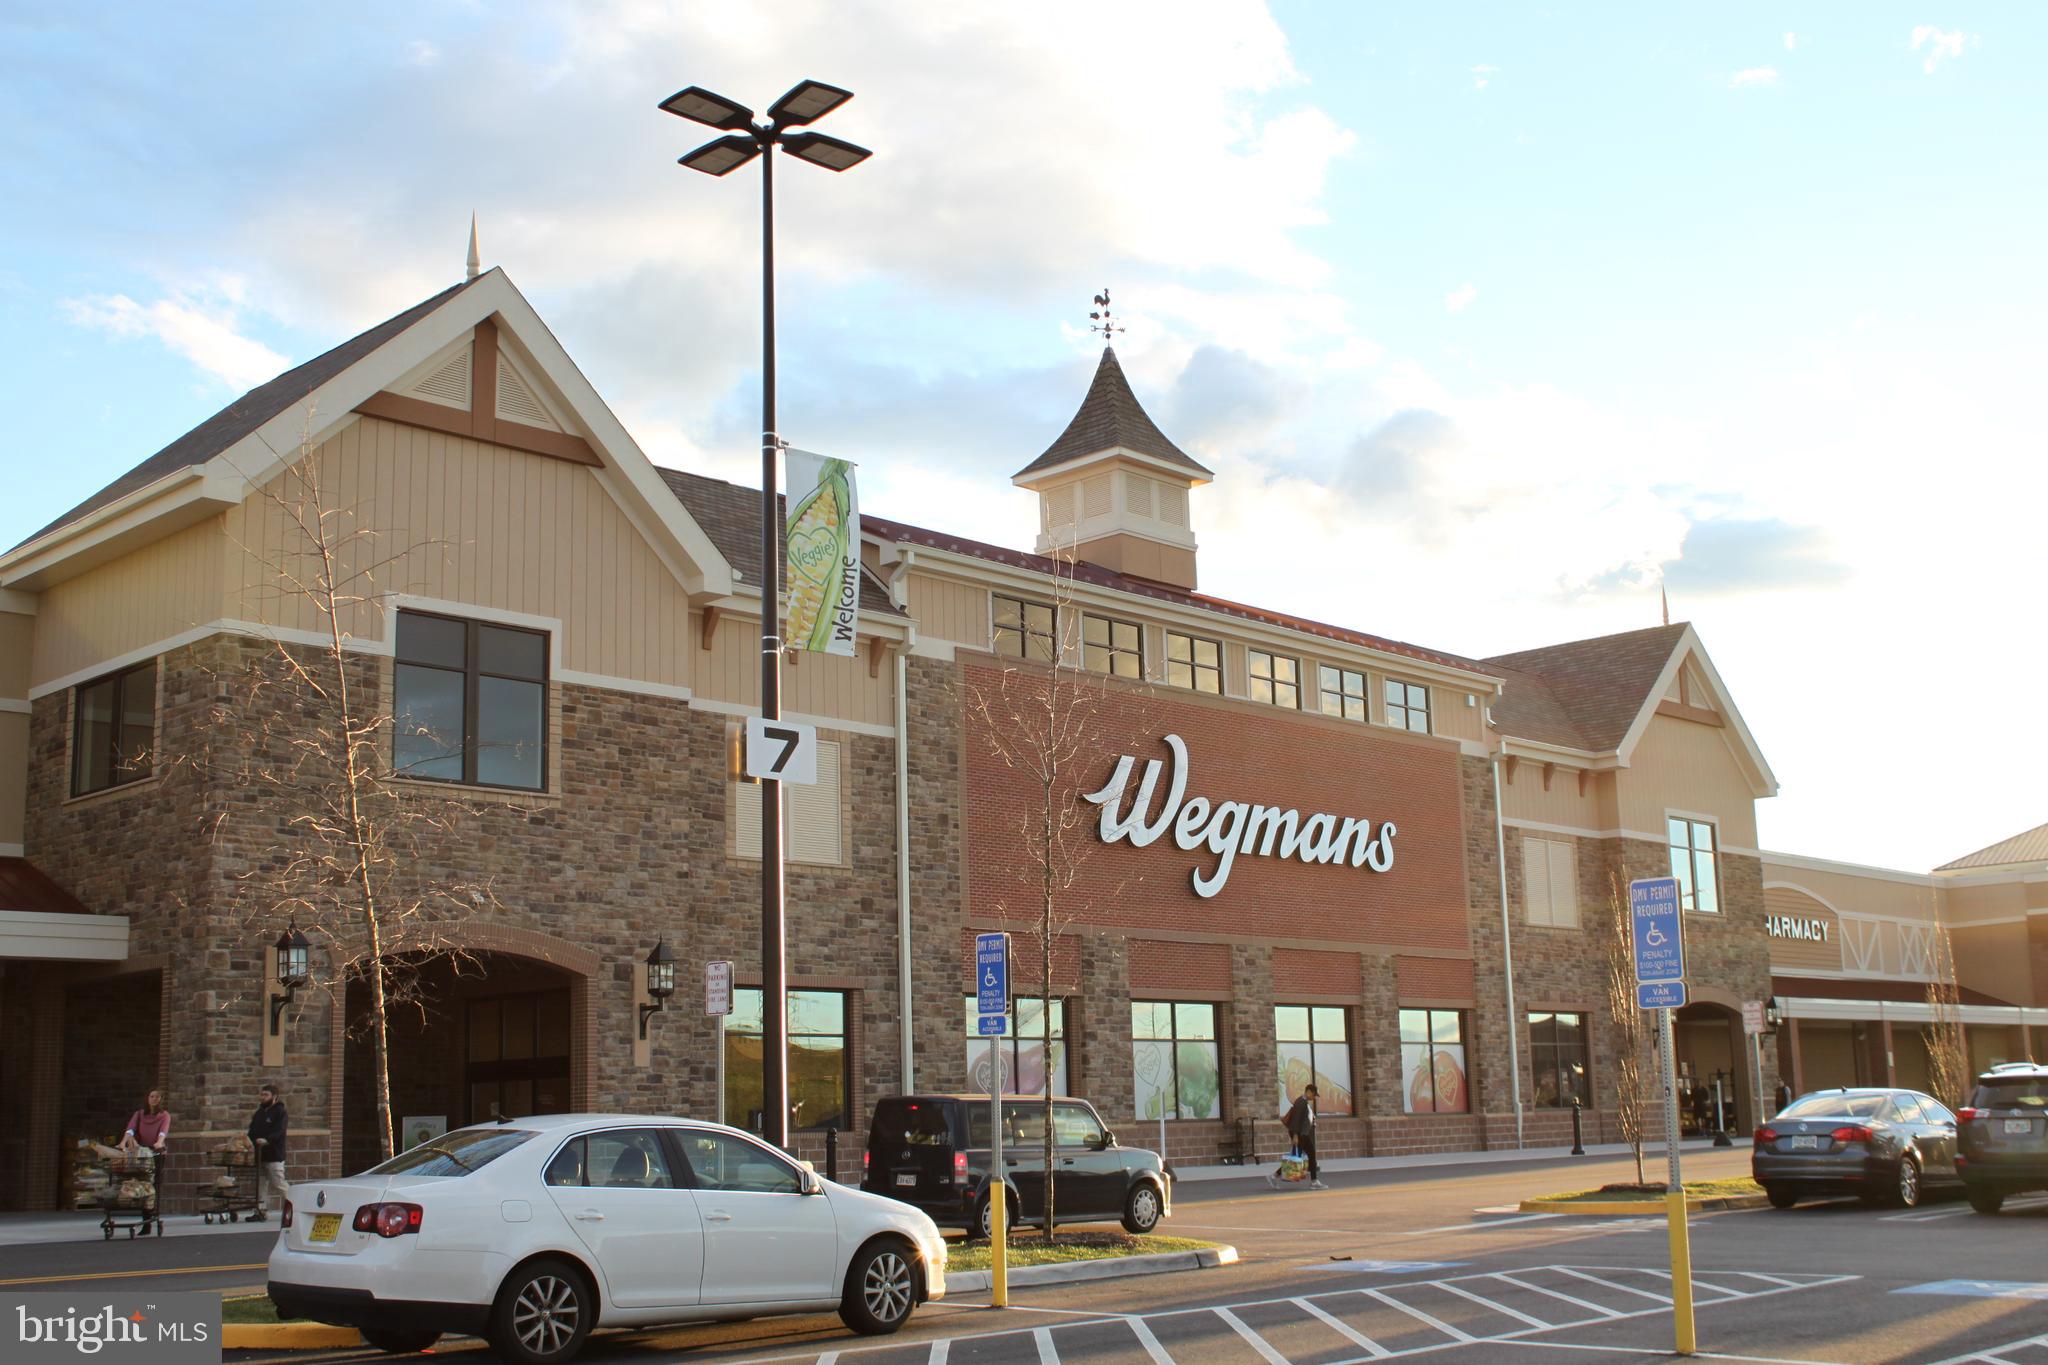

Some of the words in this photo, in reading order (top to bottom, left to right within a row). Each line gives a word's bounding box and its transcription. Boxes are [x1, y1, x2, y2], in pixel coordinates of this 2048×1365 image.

[791, 538, 835, 568] Veggies
[832, 555, 857, 641] Welcome
[764, 726, 799, 773] 7
[1082, 733, 1398, 898] Wegmans
[1632, 888, 1648, 902] DMV
[1650, 885, 1675, 900] PERMIT
[1636, 902, 1673, 917] REQUIRED
[979, 953, 1002, 964] REQUIRED
[1642, 949, 1673, 960] PENALTY
[1665, 959, 1679, 967] FINE
[1652, 987, 1669, 996] VAN
